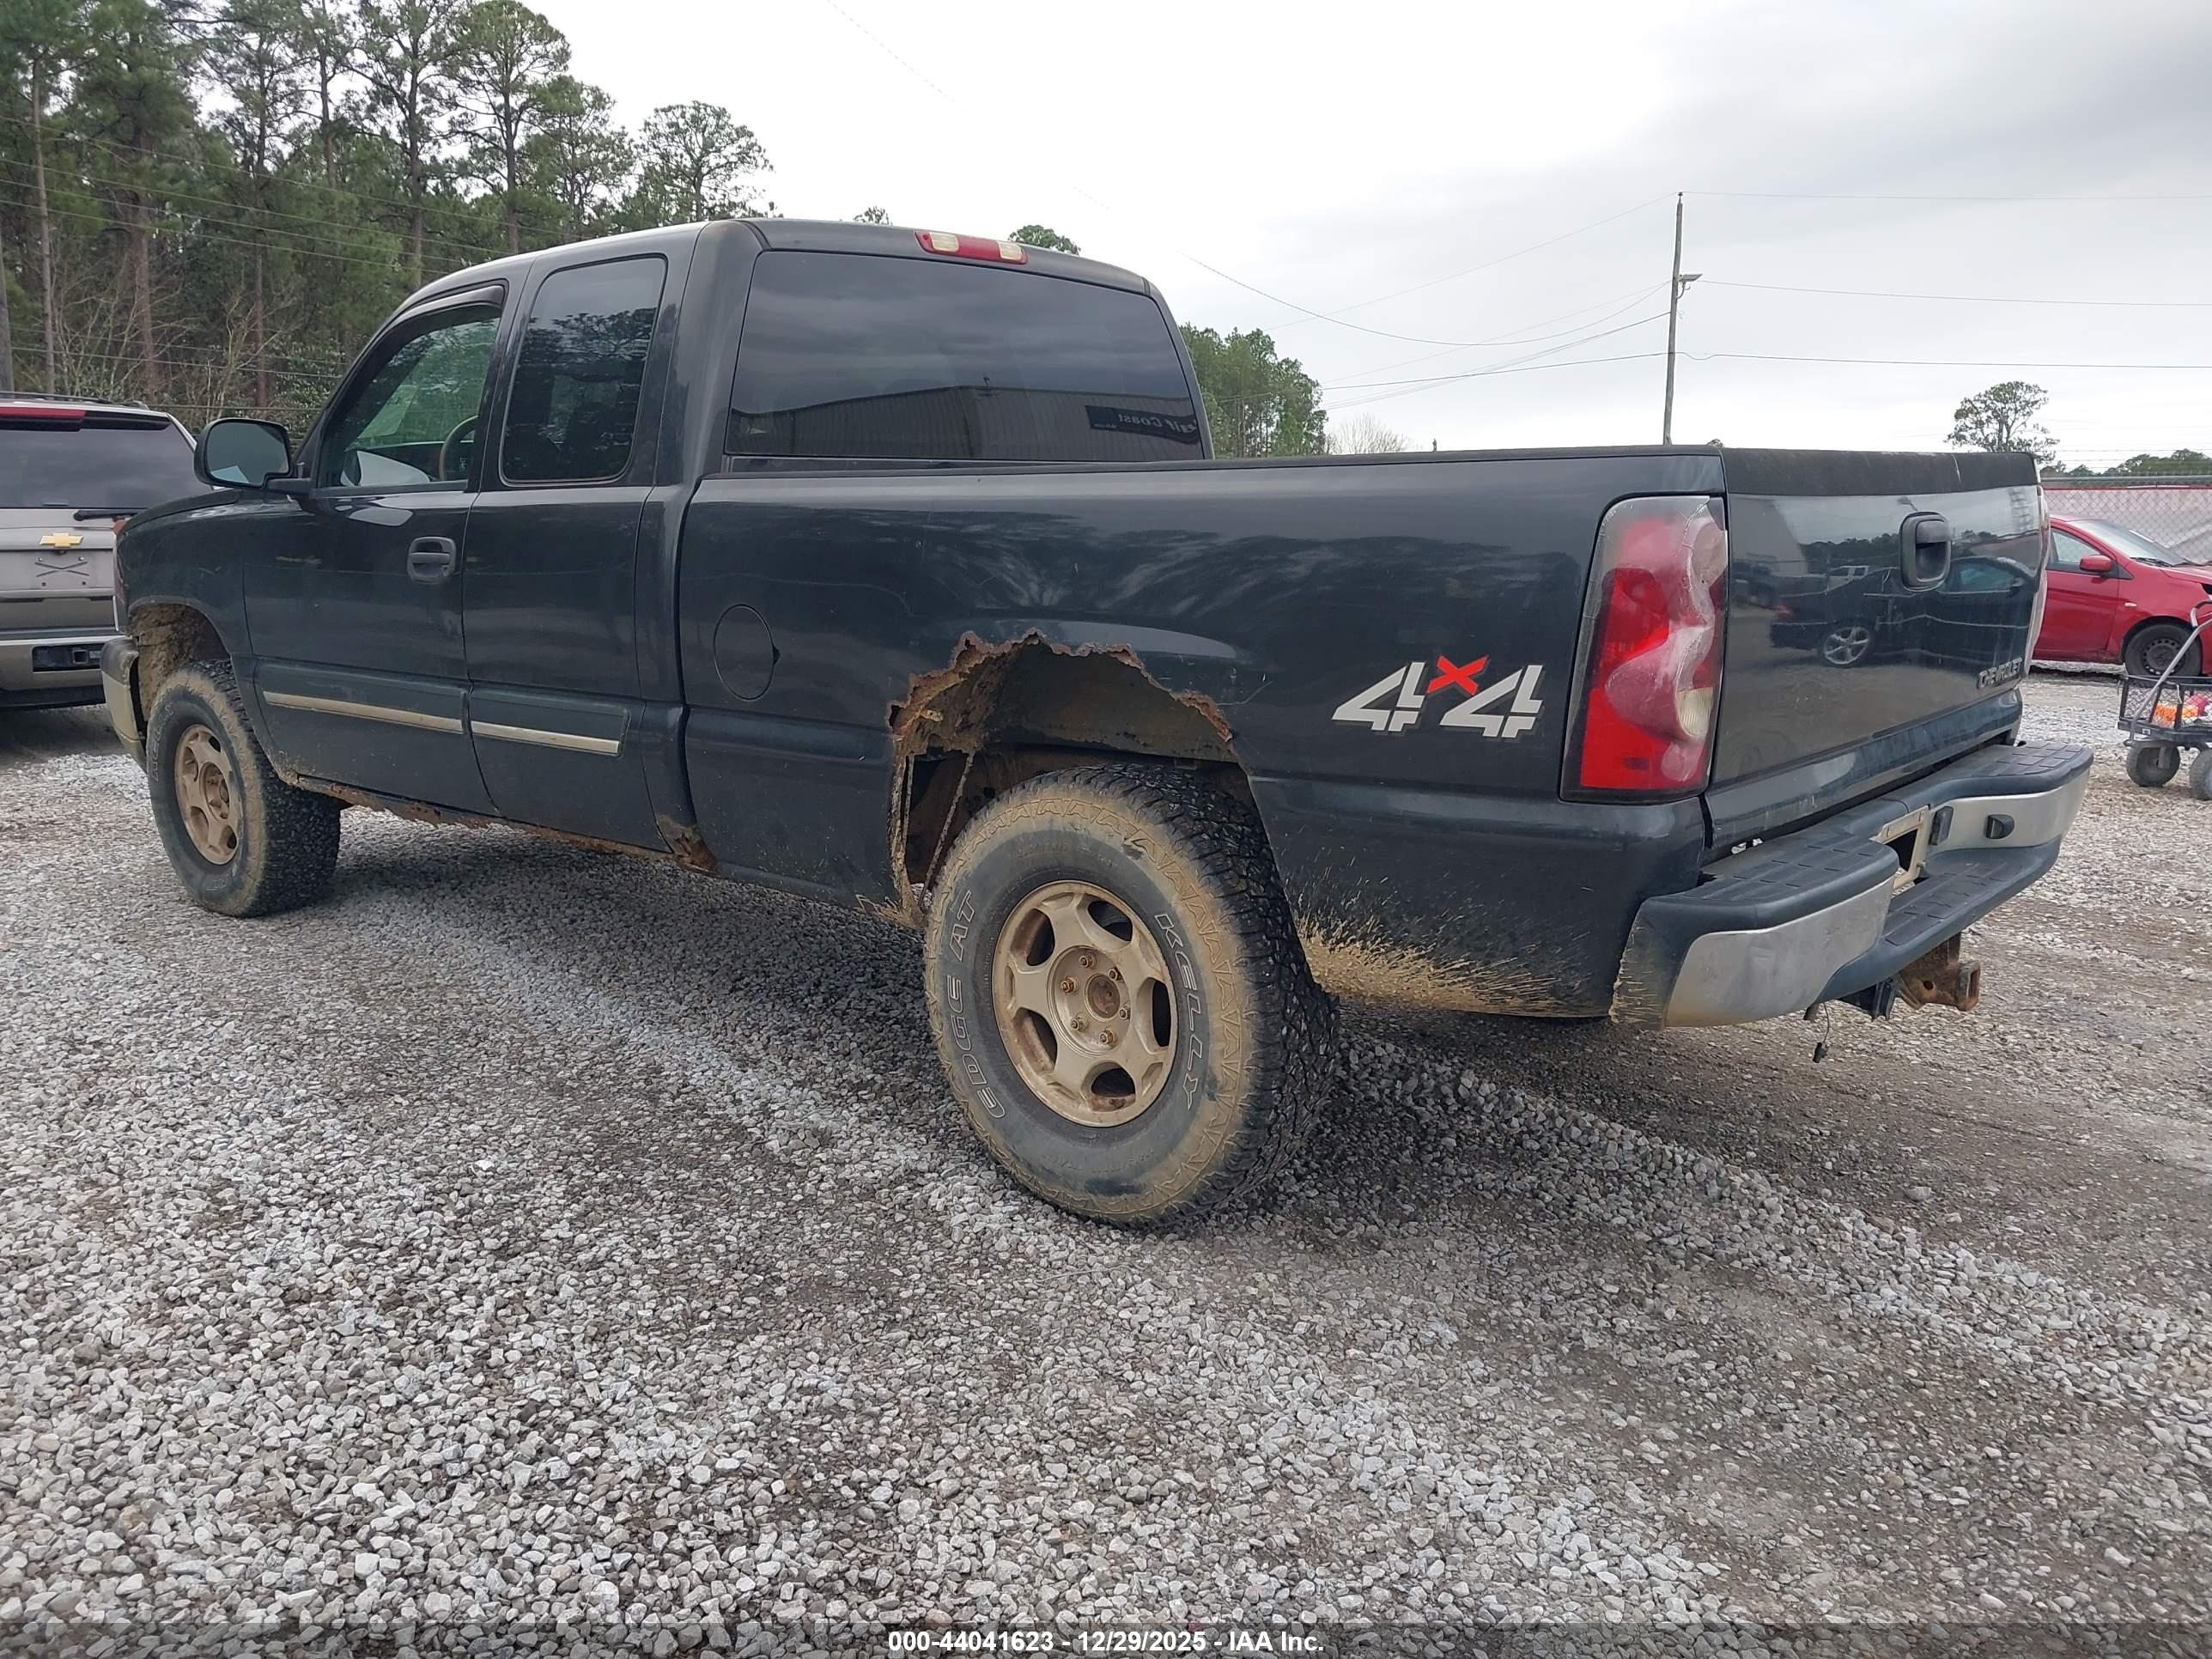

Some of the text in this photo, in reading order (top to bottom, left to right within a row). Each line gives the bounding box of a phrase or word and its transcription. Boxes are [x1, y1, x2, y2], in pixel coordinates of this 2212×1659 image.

[947, 890, 1006, 1118] EDGE AT
[1155, 914, 1202, 1110] KELLY
